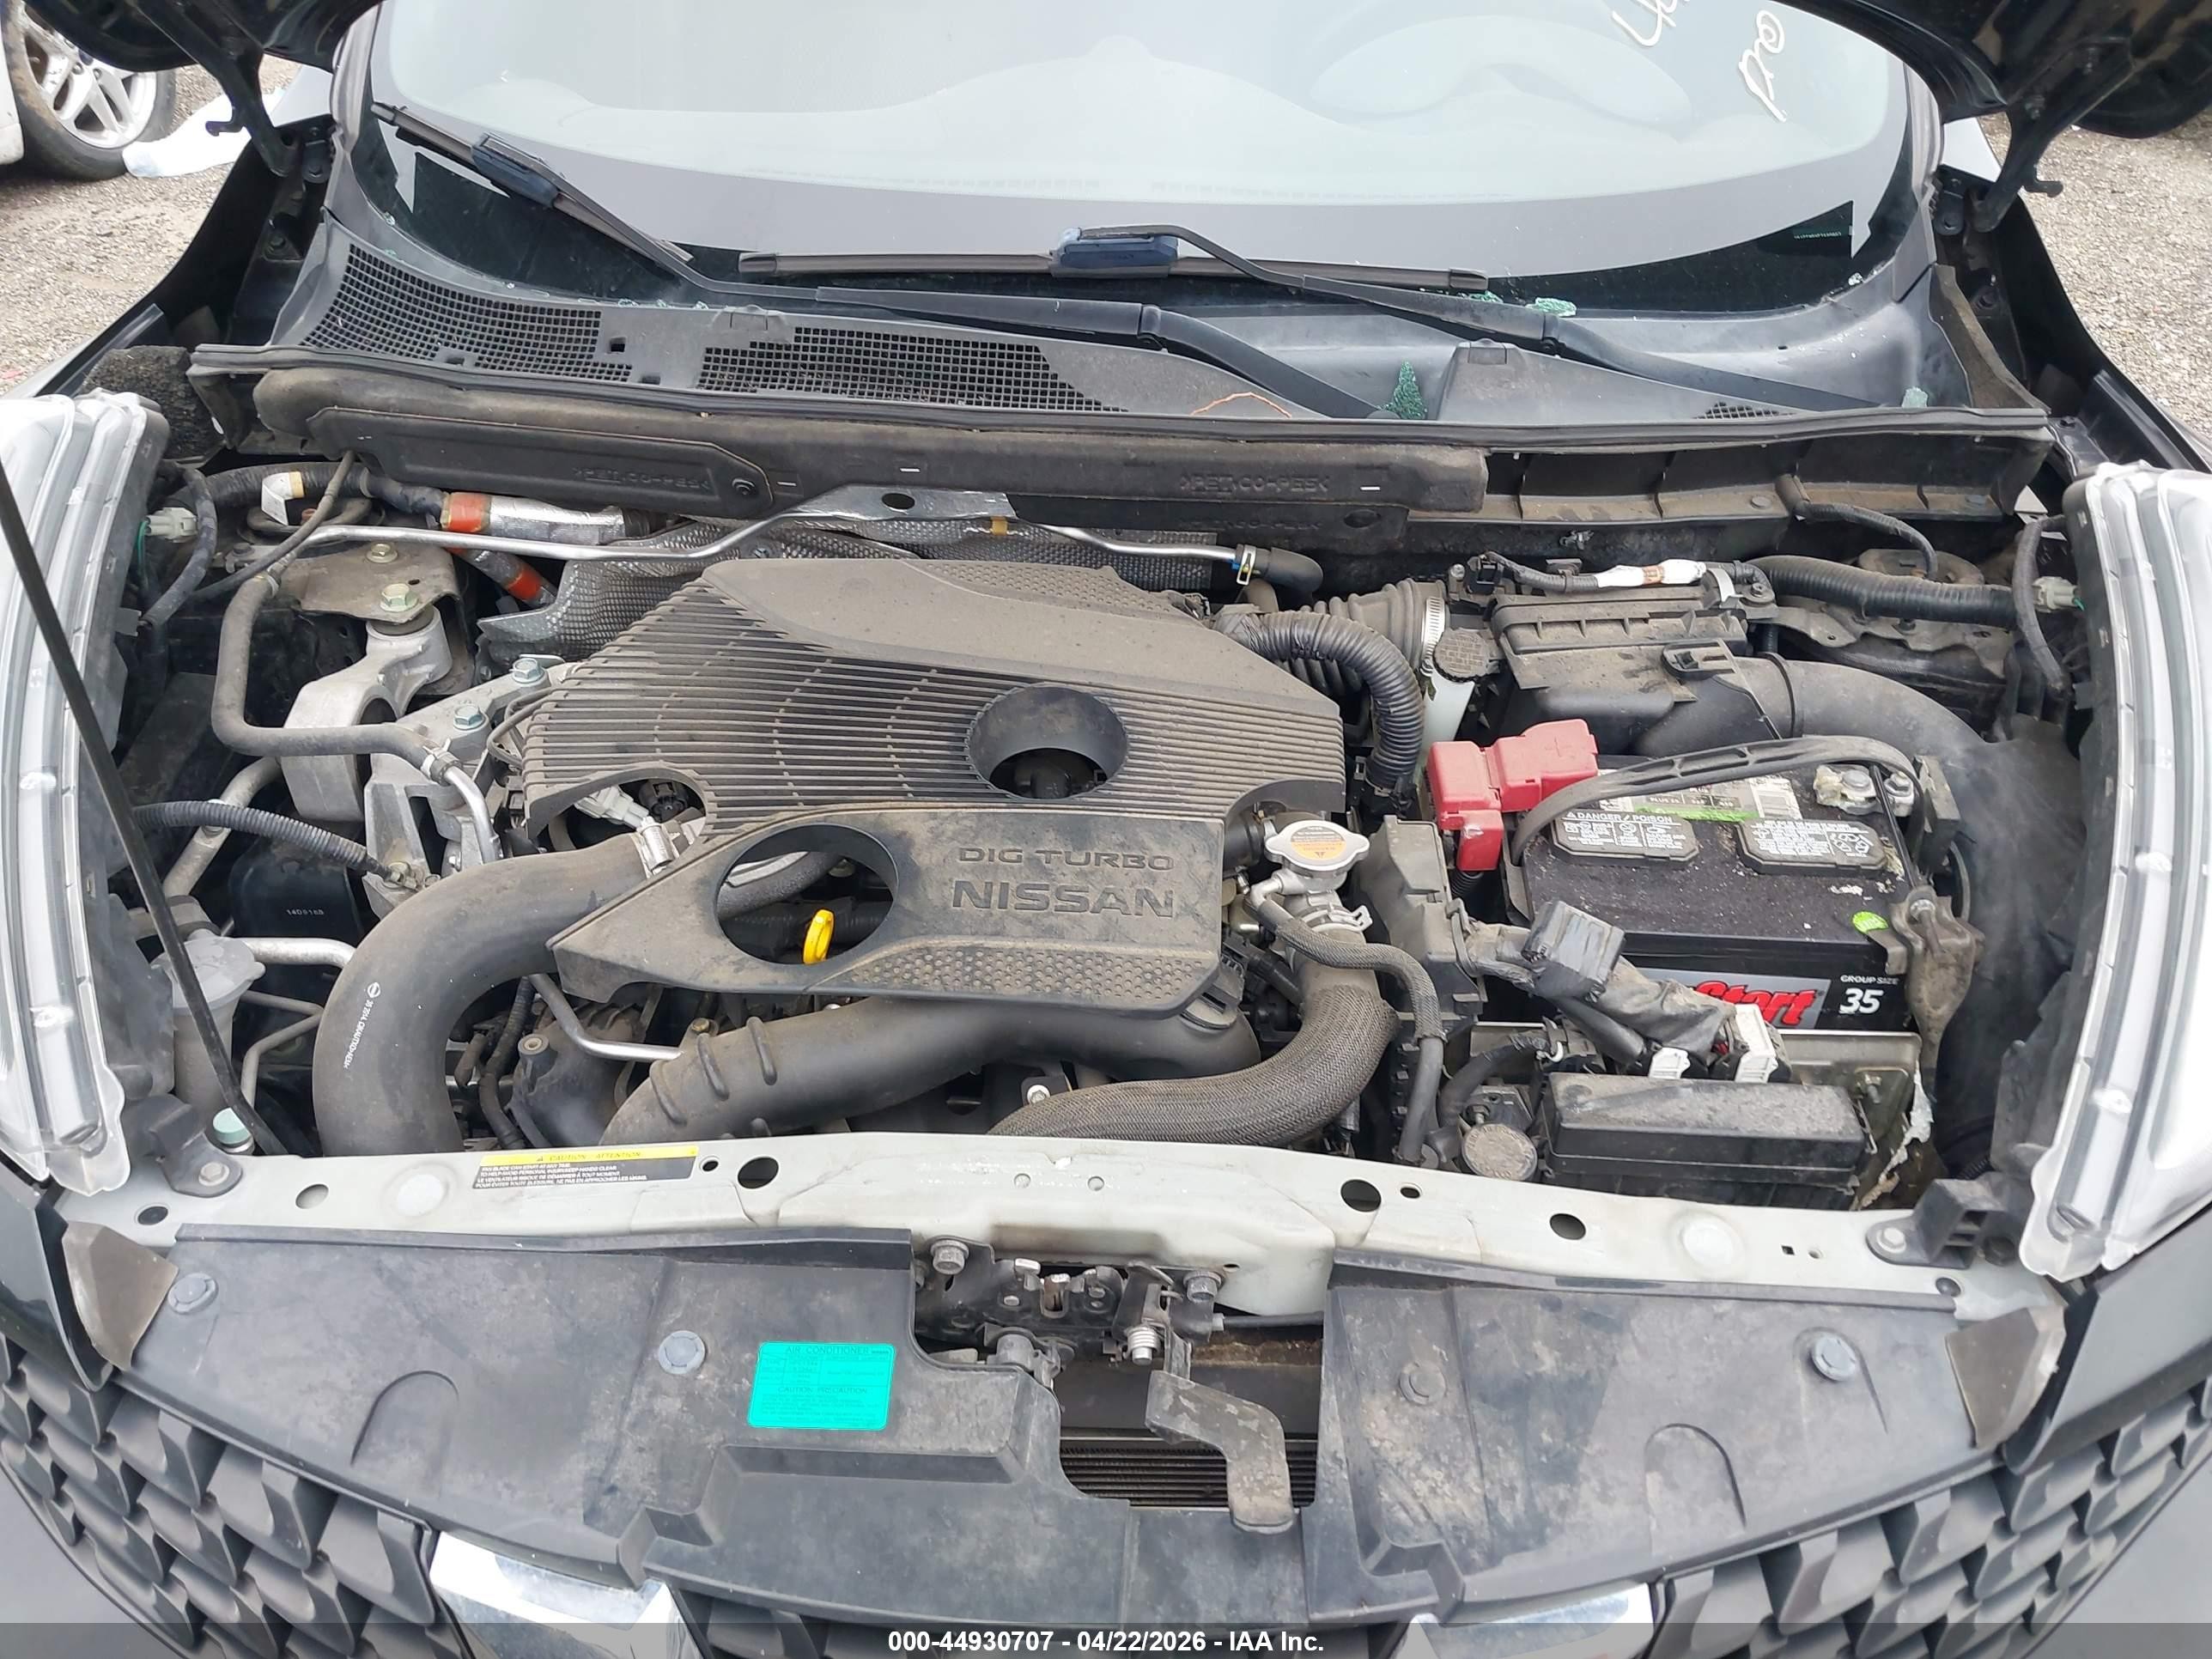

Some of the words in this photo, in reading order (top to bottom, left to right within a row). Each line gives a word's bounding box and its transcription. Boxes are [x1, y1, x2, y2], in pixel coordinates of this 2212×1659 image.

[1577, 812, 1621, 822] DANGER
[1633, 815, 1673, 823] POISON
[958, 847, 1024, 864] DIG
[1035, 848, 1175, 871] TURBO
[952, 879, 1174, 918] NISSAN
[1840, 975, 1875, 984] GROUP
[1876, 976, 1899, 985] SIZE
[1838, 988, 1885, 1015] 35
[787, 1346, 801, 1354] AIR
[805, 1346, 869, 1355] CONDITIONER
